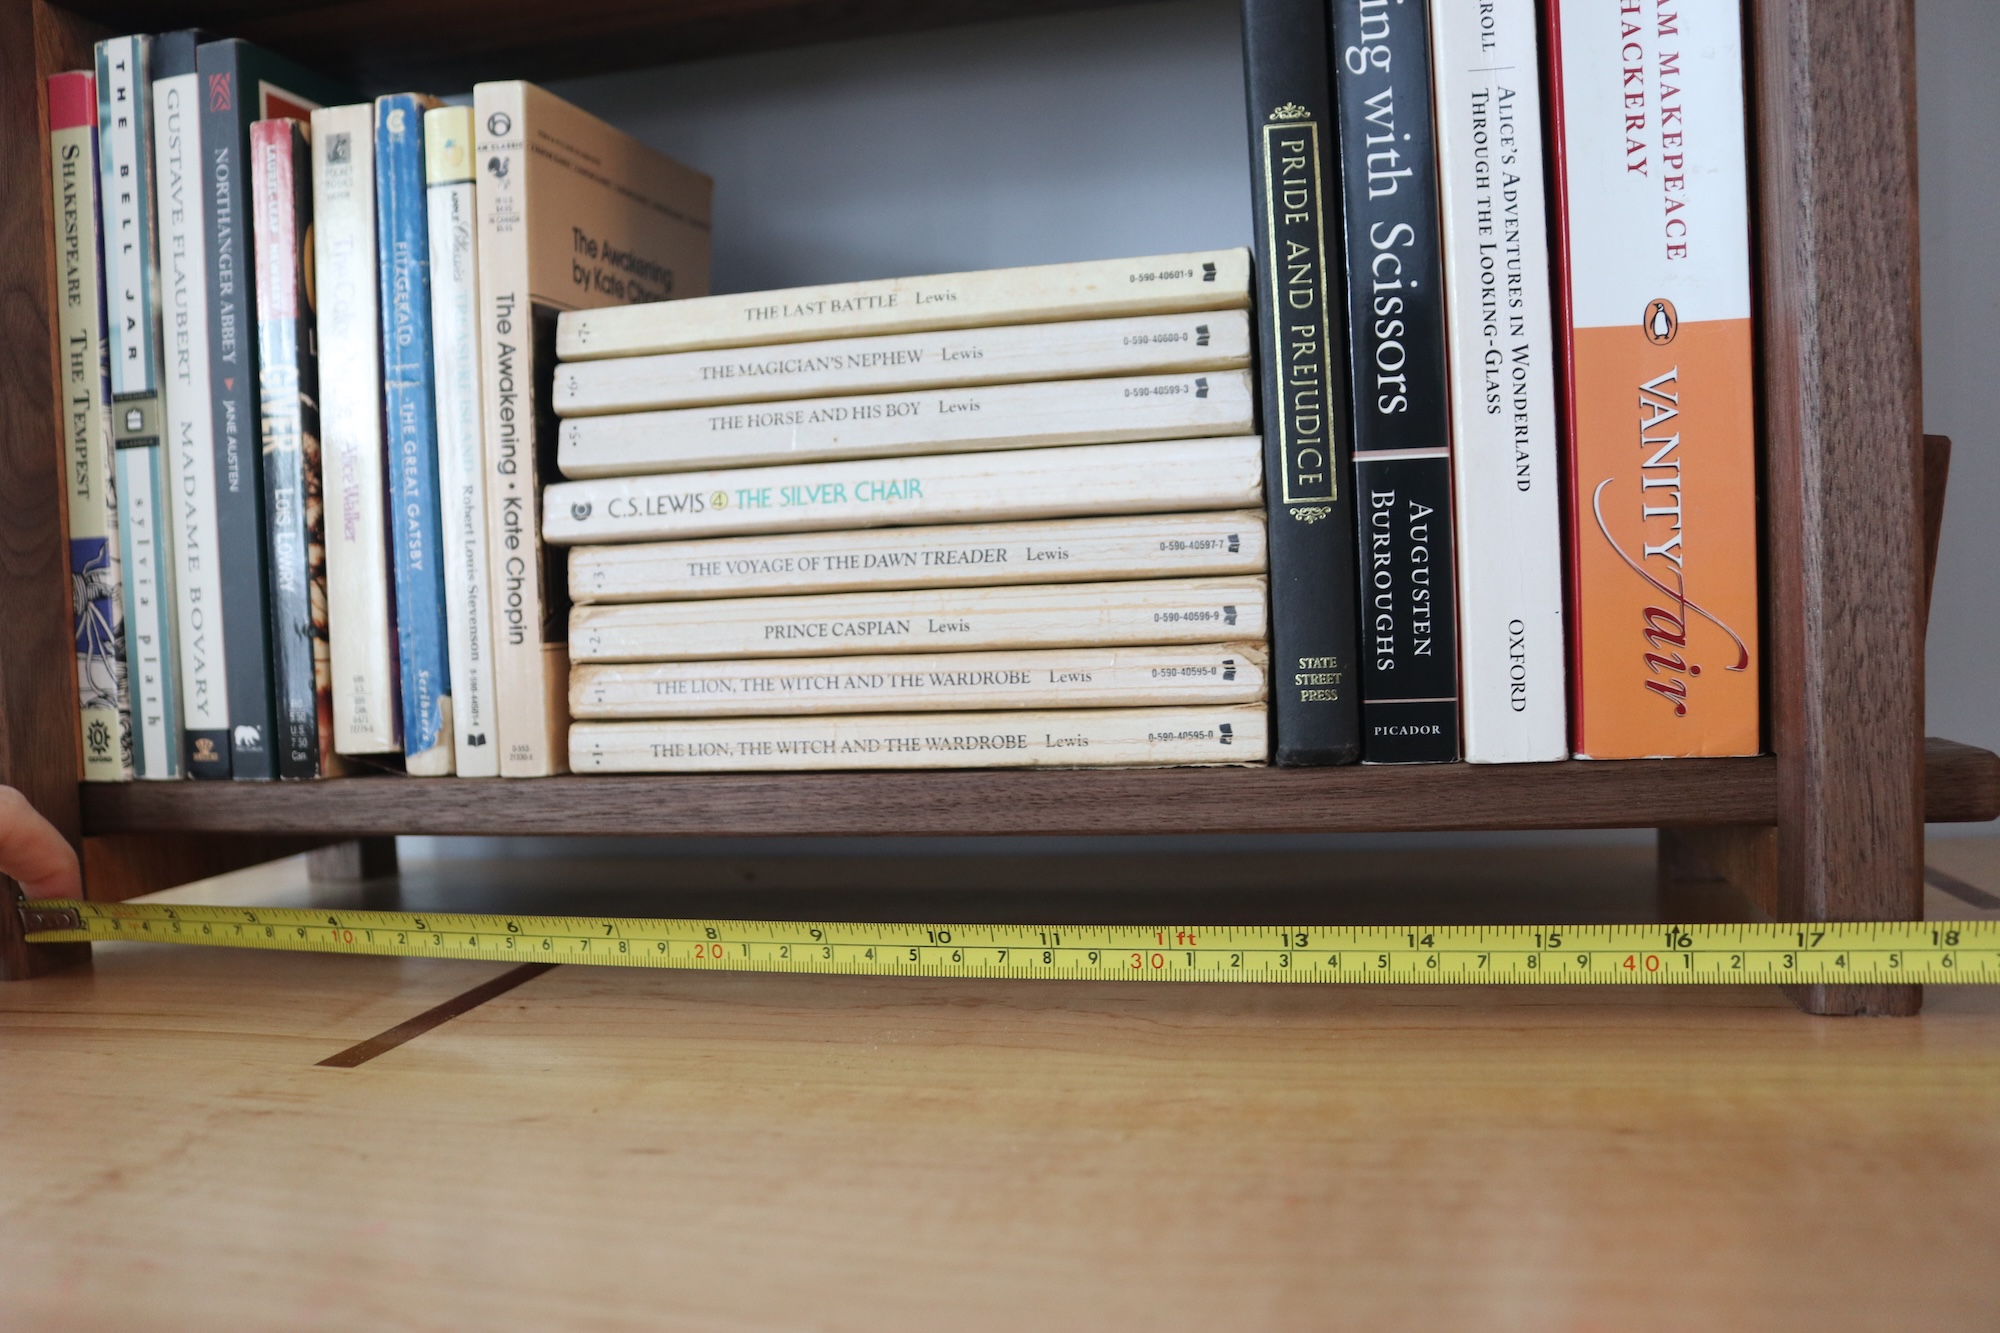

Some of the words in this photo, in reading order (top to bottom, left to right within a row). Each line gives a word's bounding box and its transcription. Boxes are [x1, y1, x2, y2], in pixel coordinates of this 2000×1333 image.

[115, 59, 128, 129] THE
[1496, 85, 1517, 165] ALICE'S
[166, 88, 185, 226] GUSTAVE
[1363, 85, 1413, 201] with
[1471, 87, 1491, 190] THROUGH
[1659, 51, 1688, 262] MAKEPEACE
[119, 164, 132, 256] BELL
[1281, 138, 1310, 226] PRIDE
[1477, 196, 1493, 237] THE
[61, 143, 82, 309] SHAKESPEARE
[213, 147, 235, 296] NORTHANGER
[1502, 171, 1524, 309] ADVENTURES
[393, 241, 413, 347] FITZGERALD
[571, 226, 598, 259] The
[601, 240, 673, 293] Awakening
[572, 257, 591, 293] by
[593, 266, 625, 299] Kate
[743, 304, 779, 322] THE
[782, 300, 828, 319] LAST
[830, 293, 899, 314] BATTLE
[915, 289, 957, 306] Lewis
[1129, 268, 1194, 283] 0-590-40601-9
[1286, 239, 1314, 310] AND
[125, 289, 138, 361] JAR
[171, 235, 192, 386] FLAUBERT
[220, 300, 237, 365] ABBEY
[454, 291, 472, 392] TREASURE
[495, 292, 515, 334] The
[1369, 221, 1420, 416] Scissors
[1479, 243, 1503, 415] LOOKING-GLASS
[1509, 314, 1524, 337] IN
[69, 328, 88, 384] THE
[700, 363, 736, 381] THE
[737, 356, 843, 378] MAGICIAN'S
[846, 349, 924, 369] NEPHEW
[941, 346, 984, 362] Lewis
[221, 399, 238, 436] JANE
[401, 401, 417, 433] THE
[459, 400, 474, 474] ISLAND
[497, 341, 521, 477] Awakening
[708, 414, 744, 431] THE
[746, 408, 805, 429] HORSE
[807, 406, 849, 424] AND
[851, 404, 882, 419] HIS
[885, 401, 921, 417] BOY
[939, 399, 981, 414] Lewis
[1123, 383, 1190, 399] 0-590-40599-3
[1290, 324, 1324, 487] PREJUDICE
[1510, 343, 1532, 493] WONDERLAND
[72, 388, 91, 500] TEMPEST
[226, 440, 240, 493] AUSTEN
[404, 441, 419, 497] GREAT
[1638, 364, 1684, 569] VANITY
[180, 421, 202, 573] MADAME
[343, 485, 361, 543] Walker
[462, 484, 475, 539] Robert
[502, 496, 524, 551] Kate
[645, 491, 706, 516] LEWIS
[735, 488, 773, 510] THE
[779, 482, 848, 507] SILVER
[854, 477, 924, 502] CHAIR
[131, 498, 152, 607] sylvia
[277, 532, 297, 593] LOWRY
[407, 503, 423, 572] GATSBY
[464, 540, 477, 583] Louis
[687, 561, 722, 578] THE
[725, 557, 796, 576] VOYAGE
[797, 556, 821, 573] OF
[823, 554, 860, 571] THE
[863, 550, 918, 568] DAWN
[921, 548, 1008, 566] TREADER
[1026, 547, 1070, 562] Lewis
[1159, 539, 1225, 552] 0-590-40597-7
[505, 557, 526, 646] Chopin
[1371, 489, 1396, 671] BURROUGHS
[1408, 500, 1435, 657] AUGUSTEN
[189, 586, 210, 718] BOVARY
[466, 584, 479, 661] Stevenson
[764, 622, 828, 640] PRINCE
[831, 620, 911, 637] CASPIAN
[928, 619, 971, 633] Lewis
[1153, 611, 1220, 624] 0-590-40596-9
[138, 634, 161, 727] plath
[655, 679, 689, 695] THE
[691, 678, 738, 697] LION,
[740, 677, 775, 693] THE
[779, 675, 839, 692] WITCH
[843, 674, 884, 690] AND
[887, 673, 925, 689] THE
[928, 670, 1032, 688] WARDROBE
[1048, 668, 1093, 684] Lewis
[1151, 666, 1218, 679] 0-590-40595-0
[1294, 673, 1342, 687] STREET
[1298, 656, 1338, 670] STATE
[1299, 689, 1339, 702] PRESS
[1508, 618, 1527, 713] OXFORD
[417, 669, 431, 744] Scribners
[1373, 724, 1441, 737] PICADOR
[650, 742, 686, 758] THE
[687, 741, 734, 759] LION,
[737, 740, 773, 756] THE
[775, 739, 836, 755] WITCH
[840, 738, 881, 754] AND
[884, 737, 921, 753] THE
[924, 734, 1028, 751] WARDROBE
[1044, 733, 1090, 749] Lewis
[164, 908, 178, 920] 2
[246, 911, 258, 923] 3
[327, 915, 338, 927] 4
[414, 918, 427, 931] 5
[506, 920, 519, 933] 6
[602, 924, 614, 937] 7
[704, 927, 719, 940] 8
[809, 929, 823, 942] 9
[926, 931, 952, 944] 10
[1039, 932, 1061, 946] 11
[1280, 932, 1310, 949] 13
[1407, 933, 1436, 949] 14
[1533, 933, 1563, 949] 15
[1664, 930, 1694, 948] 16
[1797, 931, 1826, 948] 17
[1931, 930, 1961, 947] 18
[694, 944, 724, 959] 20
[1129, 952, 1164, 969] 30
[1622, 954, 1660, 972] 40
